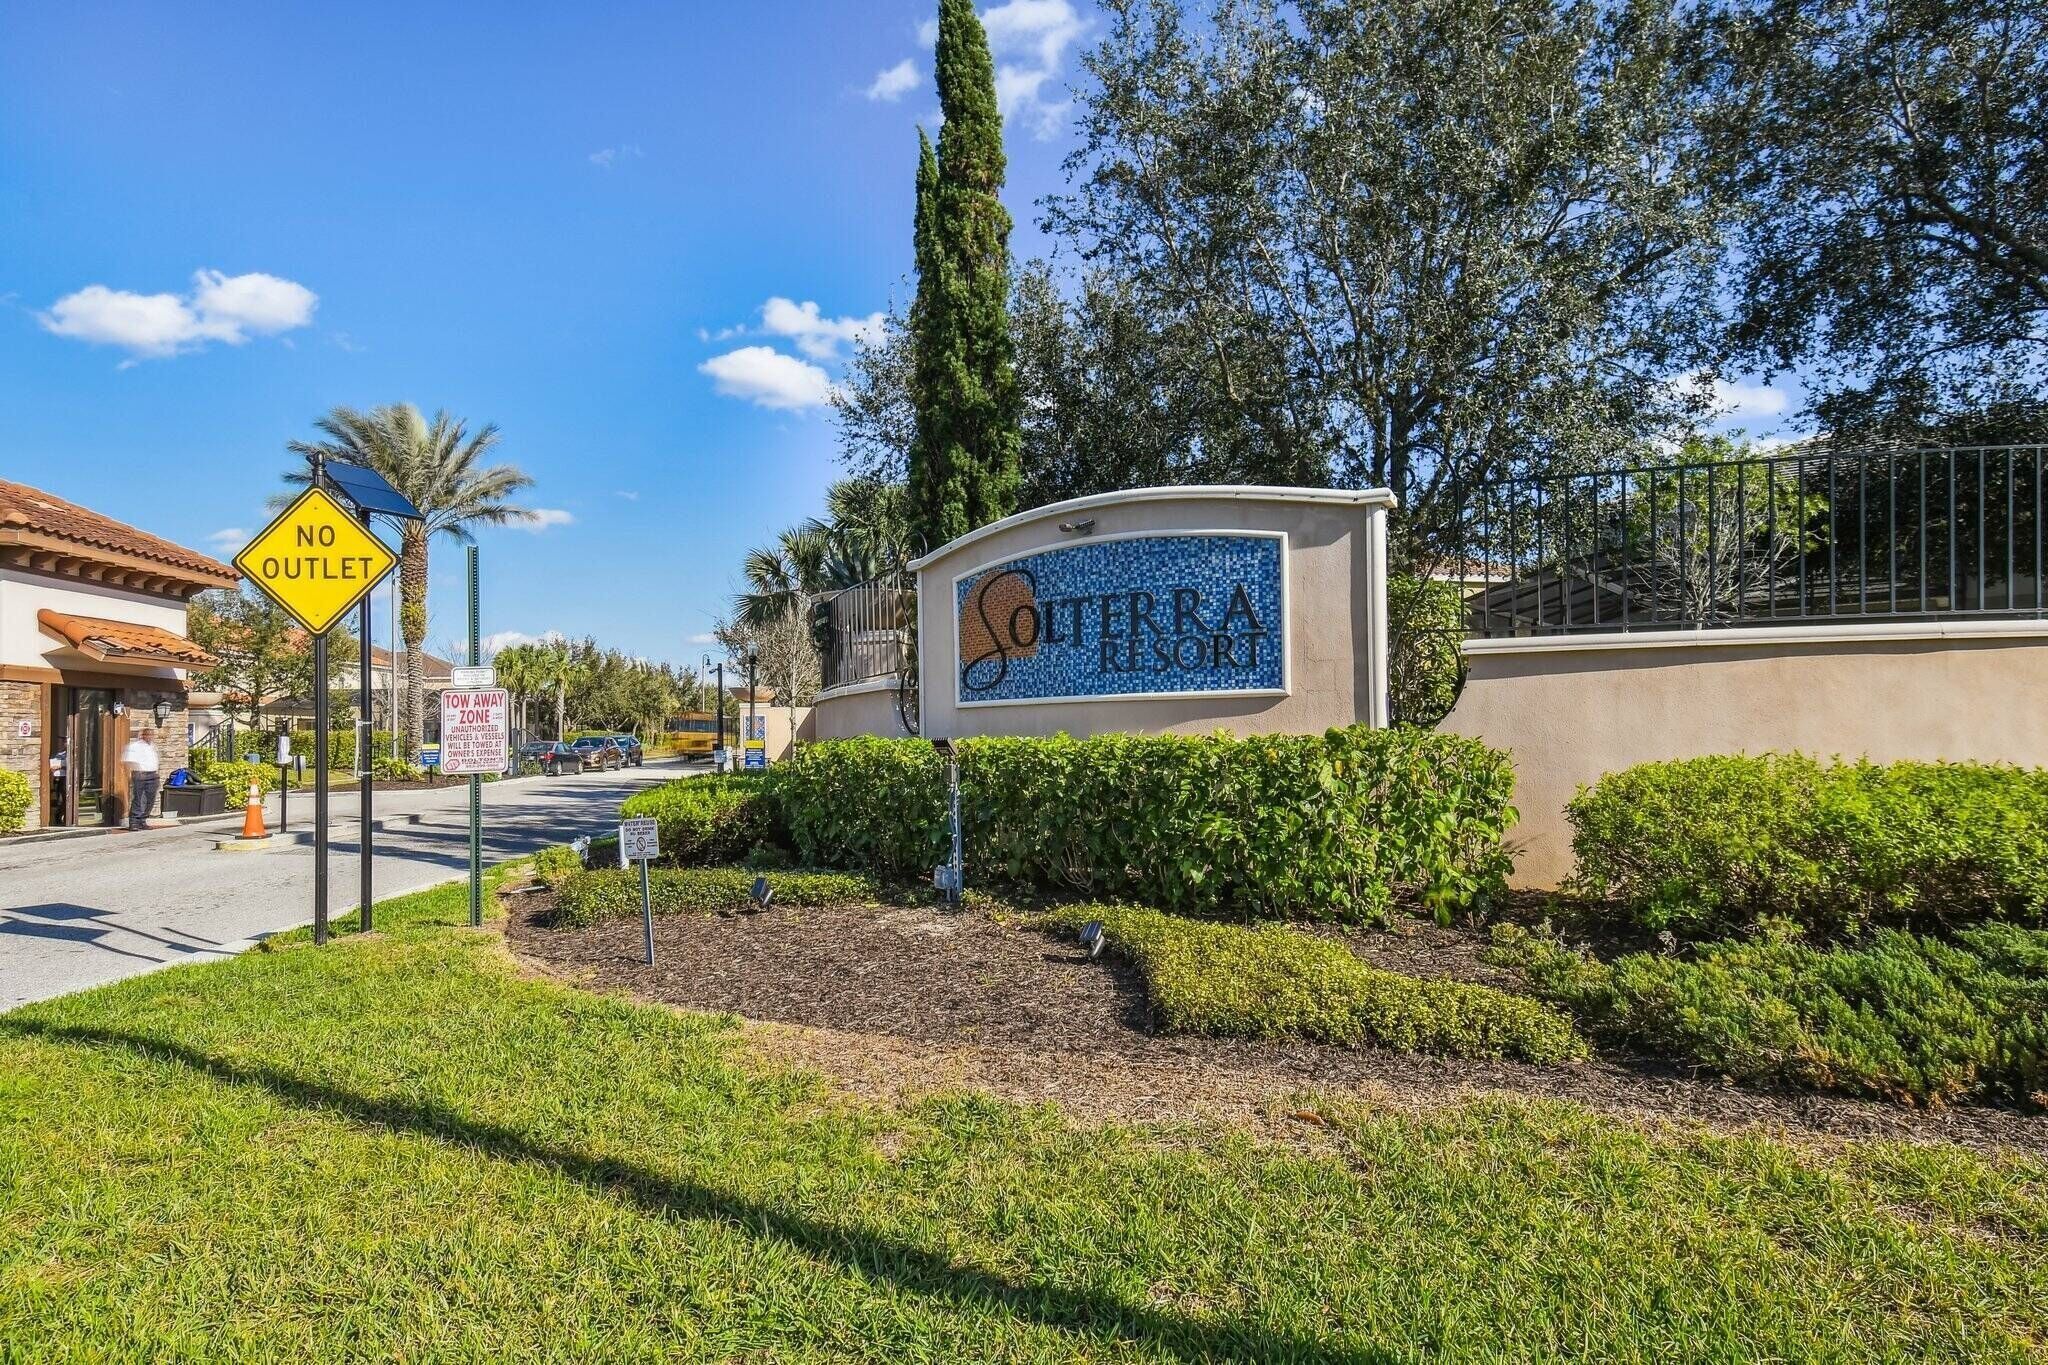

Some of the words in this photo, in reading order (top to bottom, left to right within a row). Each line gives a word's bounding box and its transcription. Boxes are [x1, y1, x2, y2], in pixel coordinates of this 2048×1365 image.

[297, 525, 335, 547] NO
[262, 557, 373, 579] OUTLET
[1100, 628, 1268, 673] RESORT
[445, 694, 470, 709] TOW
[474, 693, 504, 708] AWAY
[460, 710, 490, 724] ZONE
[451, 725, 498, 733] UNAUTHORIZED
[481, 732, 504, 740] VESSELS
